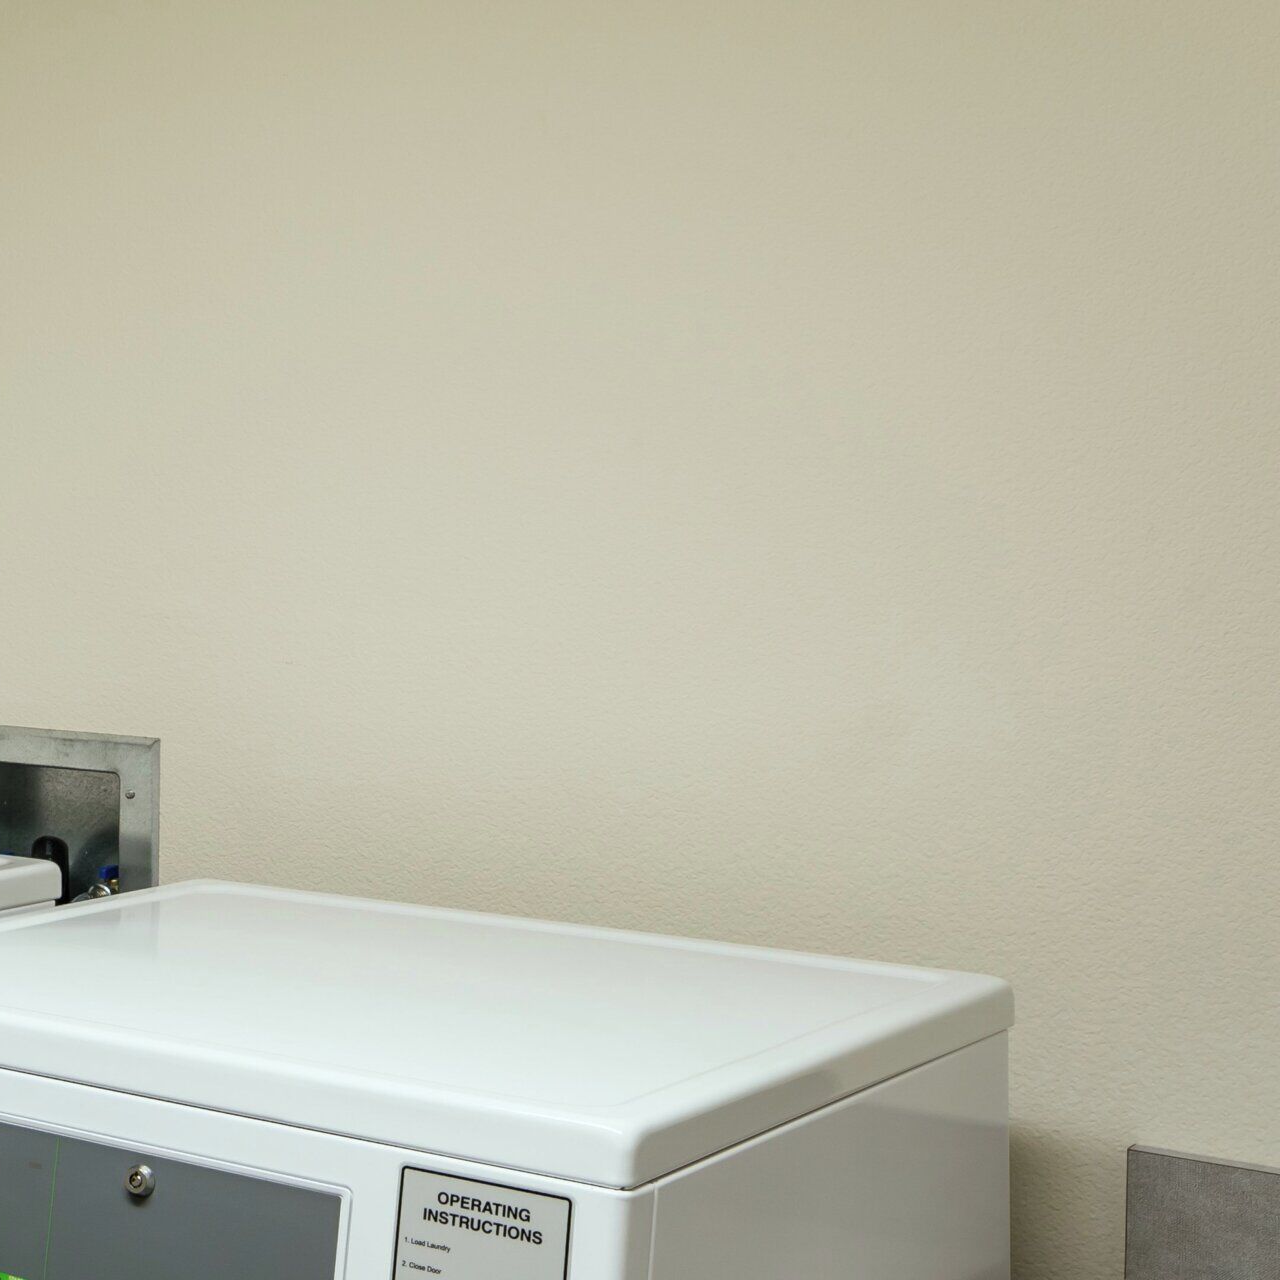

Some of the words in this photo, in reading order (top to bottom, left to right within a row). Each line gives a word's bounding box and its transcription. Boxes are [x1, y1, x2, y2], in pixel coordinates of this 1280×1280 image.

[438, 1192, 530, 1222] OPERATING
[423, 1208, 543, 1245] INSTRUCTIONS
[411, 1238, 425, 1247] Load
[427, 1241, 451, 1253] Laundry
[409, 1261, 425, 1272] Close
[427, 1265, 442, 1274] Door
